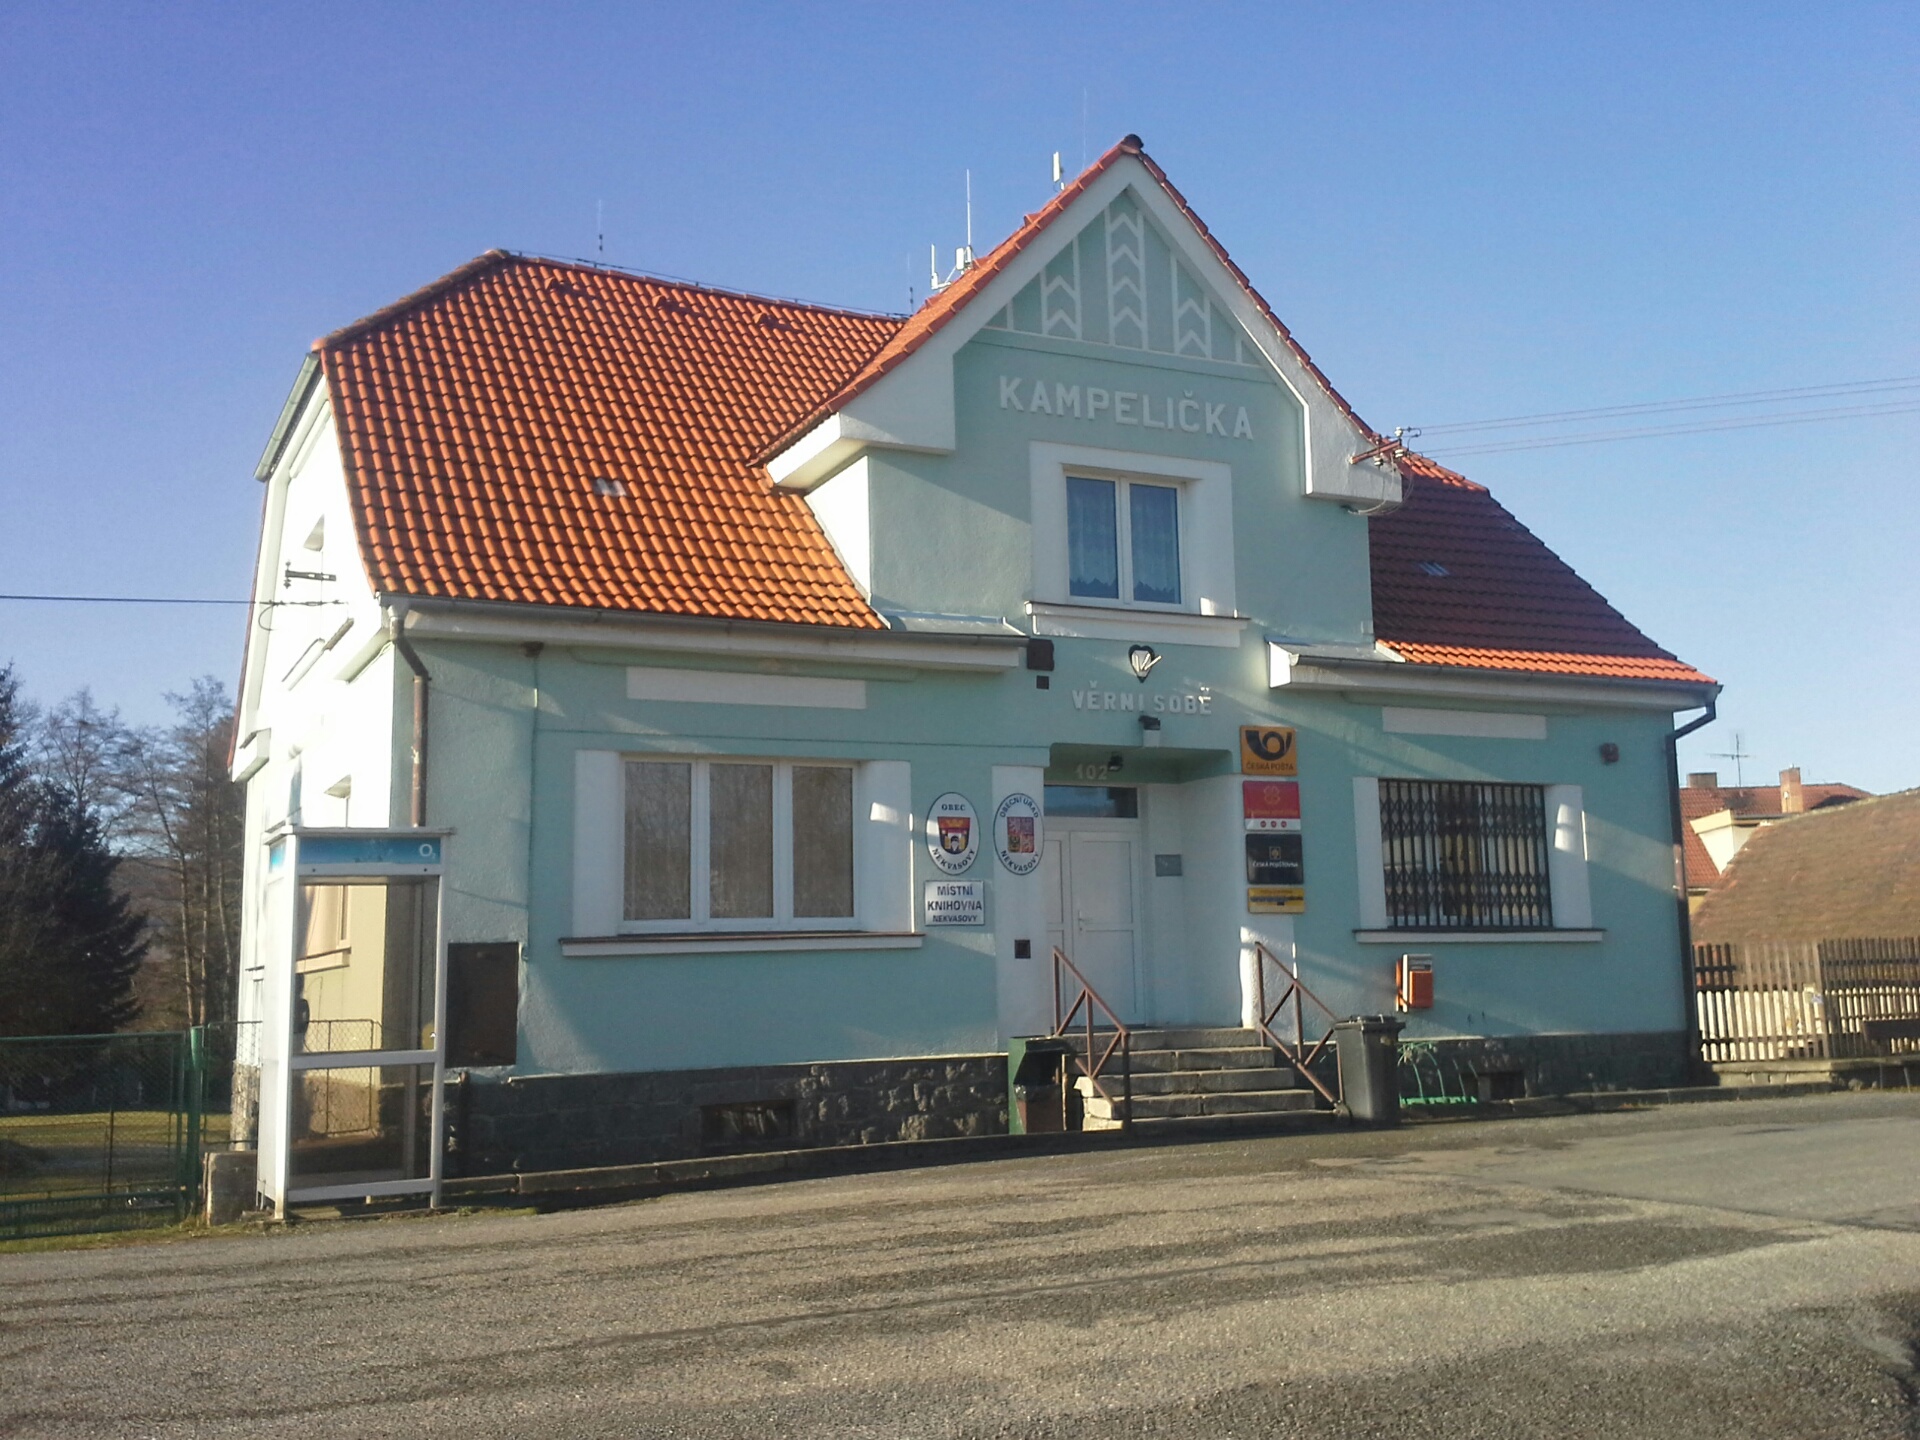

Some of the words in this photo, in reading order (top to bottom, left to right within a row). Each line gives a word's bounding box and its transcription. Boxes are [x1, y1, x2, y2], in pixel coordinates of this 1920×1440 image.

[998, 374, 1255, 441] KAMPELIČKA
[1071, 680, 1144, 712] VĚRNI
[1153, 686, 1212, 715] SOBĚ
[1075, 764, 1108, 780] 102
[941, 803, 966, 811] OBEC
[932, 847, 976, 871] NEKVASOVY
[1000, 850, 1040, 872] NEKVASOVY
[937, 884, 973, 896] MÍSTNÍ
[927, 900, 983, 911] KNIHOVNA
[932, 914, 978, 923] NEKVASOVY
